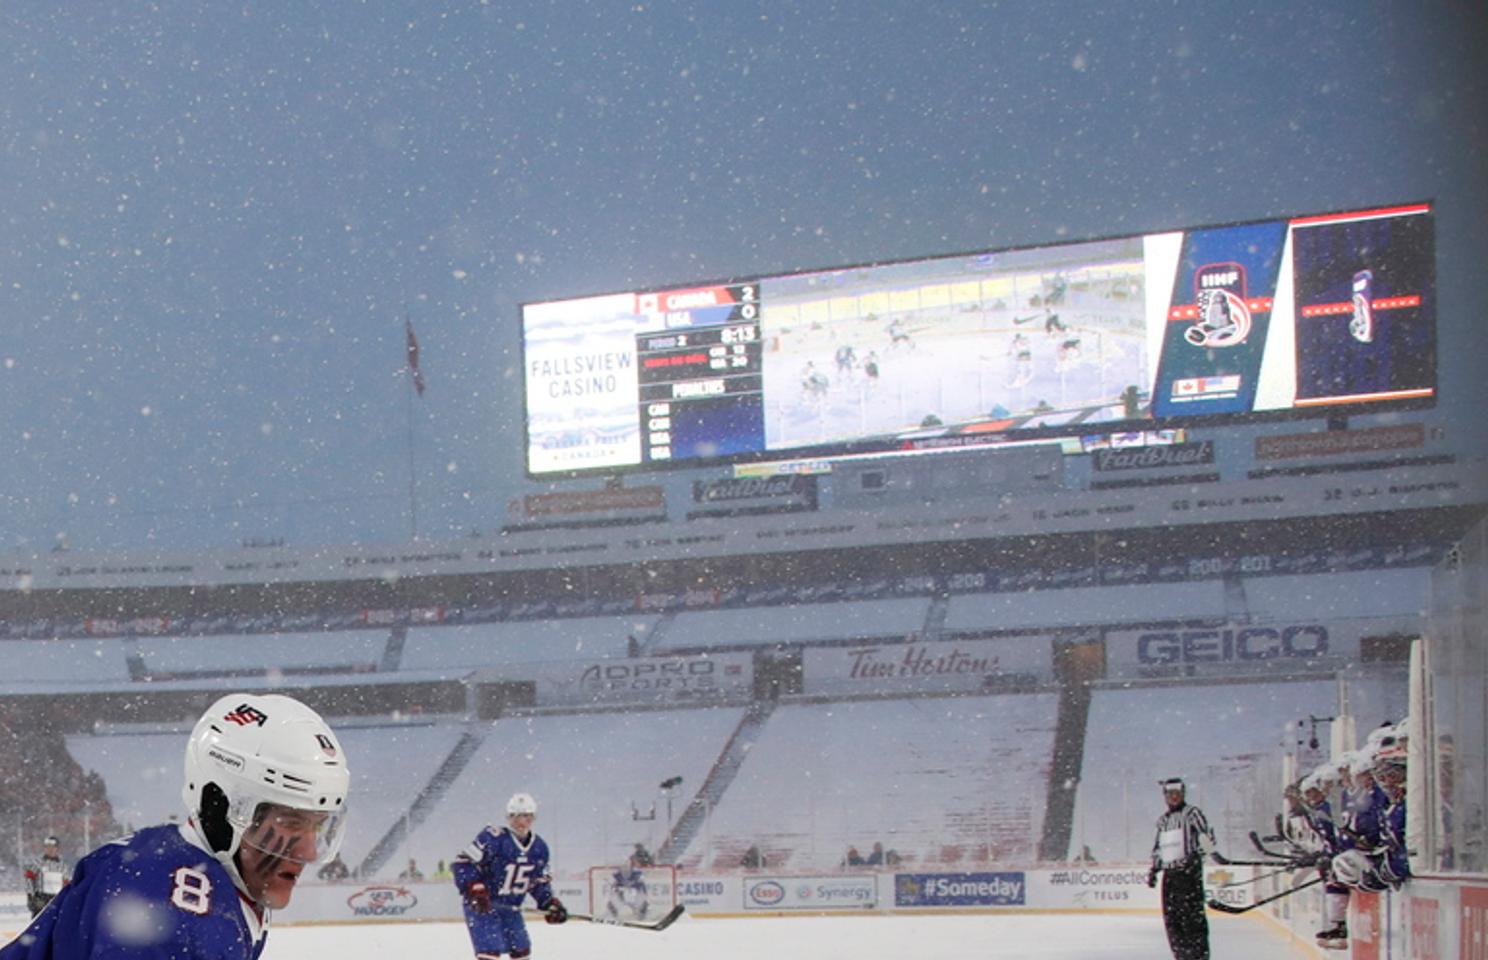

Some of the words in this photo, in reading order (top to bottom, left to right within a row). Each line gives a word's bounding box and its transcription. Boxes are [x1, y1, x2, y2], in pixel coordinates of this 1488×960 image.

[742, 286, 754, 302] 2
[741, 304, 755, 318] 0
[531, 352, 633, 377] FALLSVIEW
[549, 374, 617, 399] CASINO
[1137, 625, 1329, 665] GEICO
[847, 648, 895, 679] Tim
[579, 661, 716, 690] ADPRO
[170, 866, 213, 915] 8
[497, 862, 536, 897] 15
[677, 881, 724, 896] CASINO
[923, 878, 1023, 899] #Someday
[816, 883, 872, 901] Synergy
[1093, 890, 1129, 900] TELUS
[353, 904, 410, 917] HOCKEY
